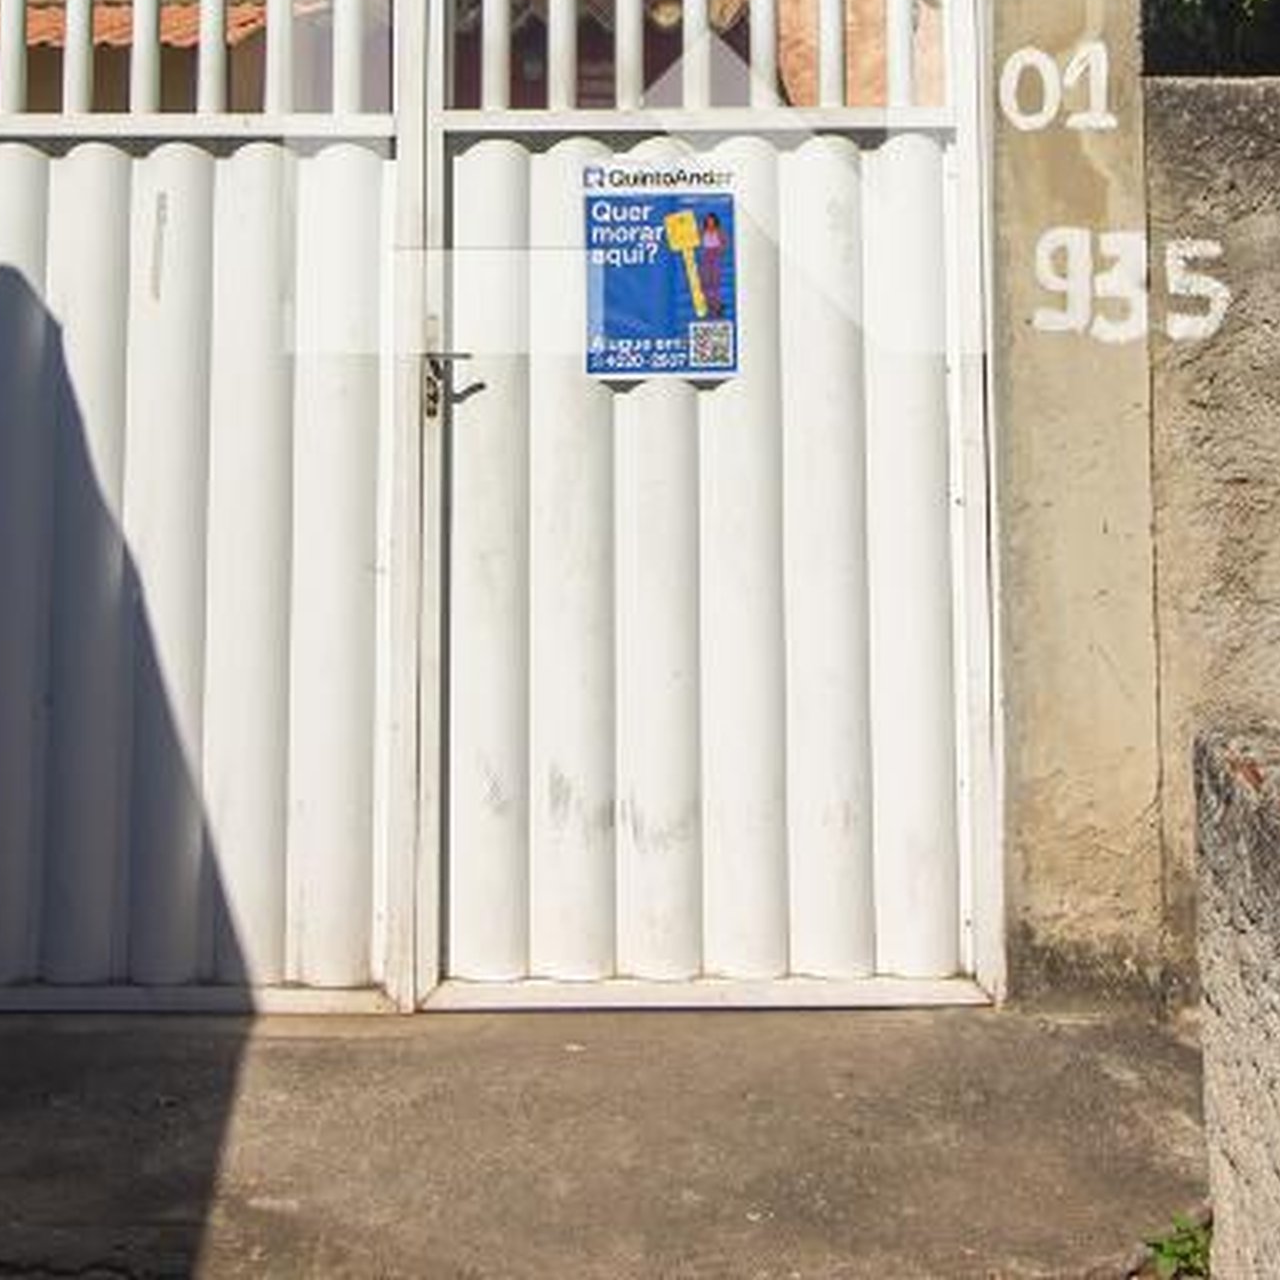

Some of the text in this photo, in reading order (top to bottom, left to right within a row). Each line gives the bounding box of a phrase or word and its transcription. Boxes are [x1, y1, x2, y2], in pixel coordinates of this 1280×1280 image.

[999, 42, 1117, 131] 01
[592, 201, 652, 223] Quer
[592, 224, 663, 243] morar
[592, 243, 658, 266] aqui?
[1033, 226, 1230, 343] 935
